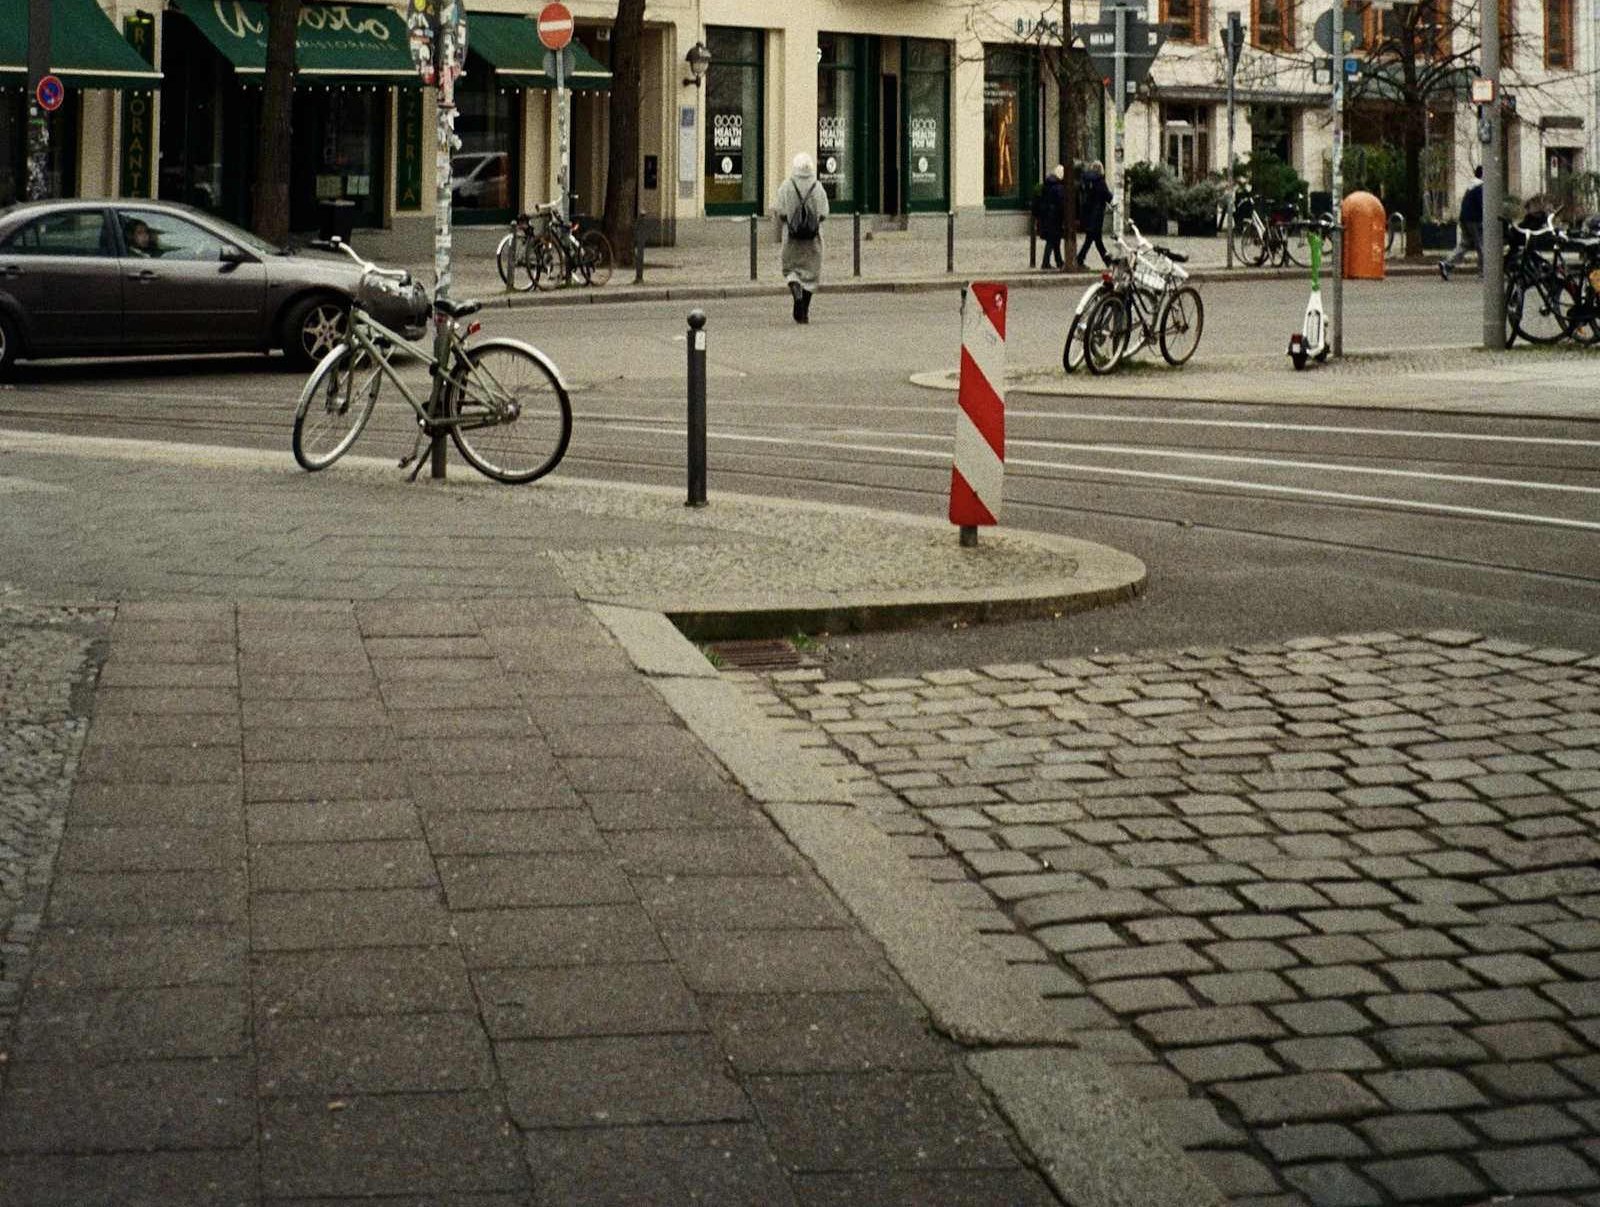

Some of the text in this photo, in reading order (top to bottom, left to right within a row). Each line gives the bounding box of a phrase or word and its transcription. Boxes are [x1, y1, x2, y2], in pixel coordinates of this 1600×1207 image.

[714, 114, 743, 128] GOOD
[820, 116, 845, 130] GOOD
[911, 118, 937, 131] GOOD
[714, 127, 742, 138] HEALTH
[911, 130, 936, 140] HEALTH
[714, 137, 742, 147] FOR ME
[820, 138, 834, 149] FOR
[911, 139, 936, 149] FOR ME
